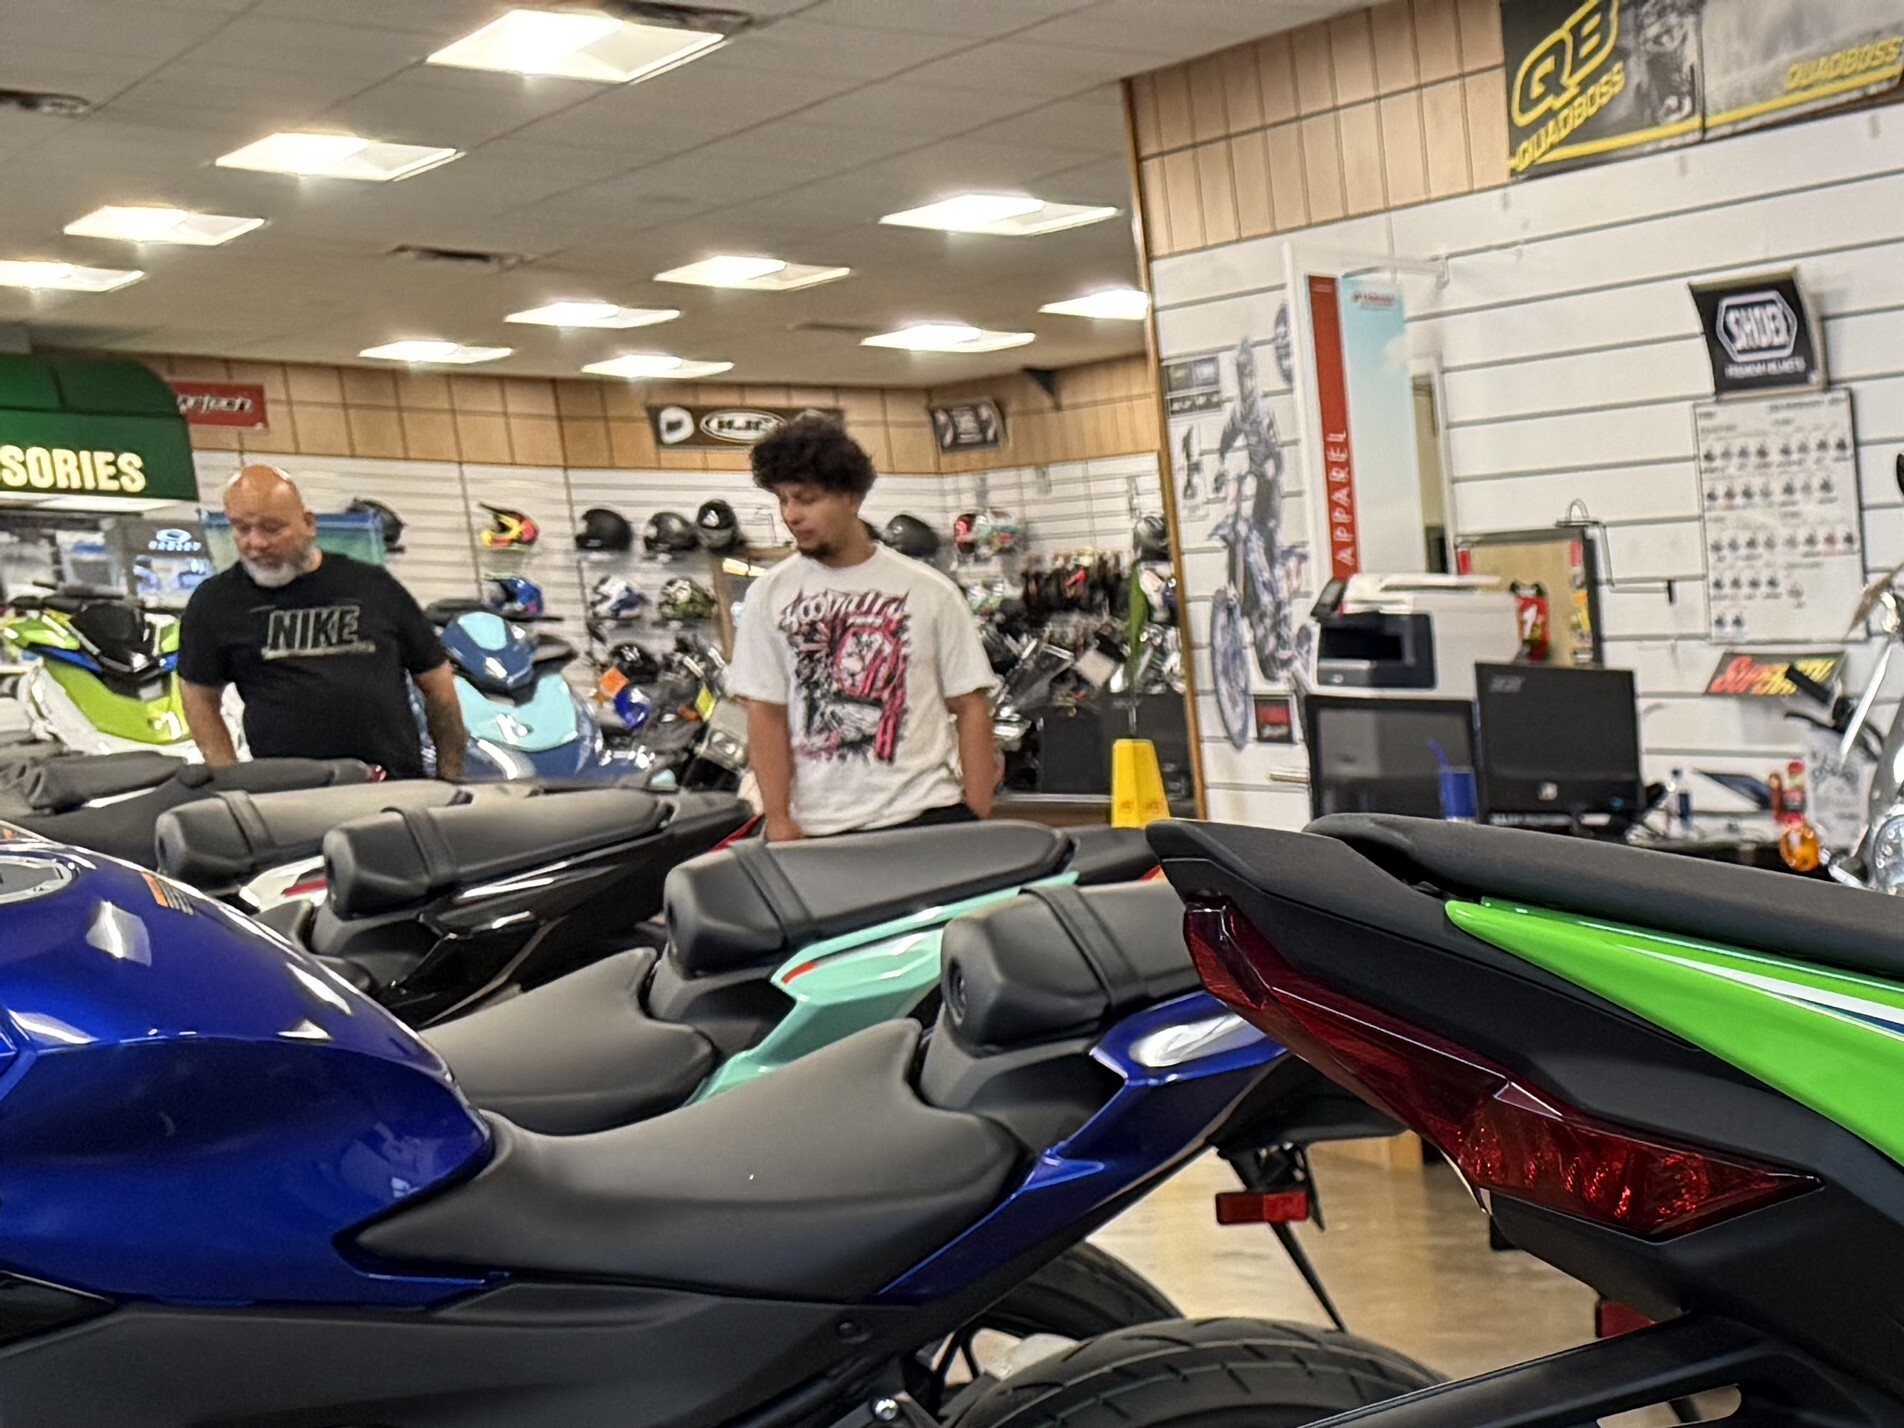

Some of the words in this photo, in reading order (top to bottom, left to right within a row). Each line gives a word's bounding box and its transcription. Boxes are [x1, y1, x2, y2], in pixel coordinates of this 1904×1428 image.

[1785, 36, 1903, 91] QUADBOSS
[1514, 62, 1626, 172] QUADBOSS
[0, 444, 147, 493] SORIES
[1327, 430, 1355, 566] APPAREL
[267, 605, 361, 651] NIKE
